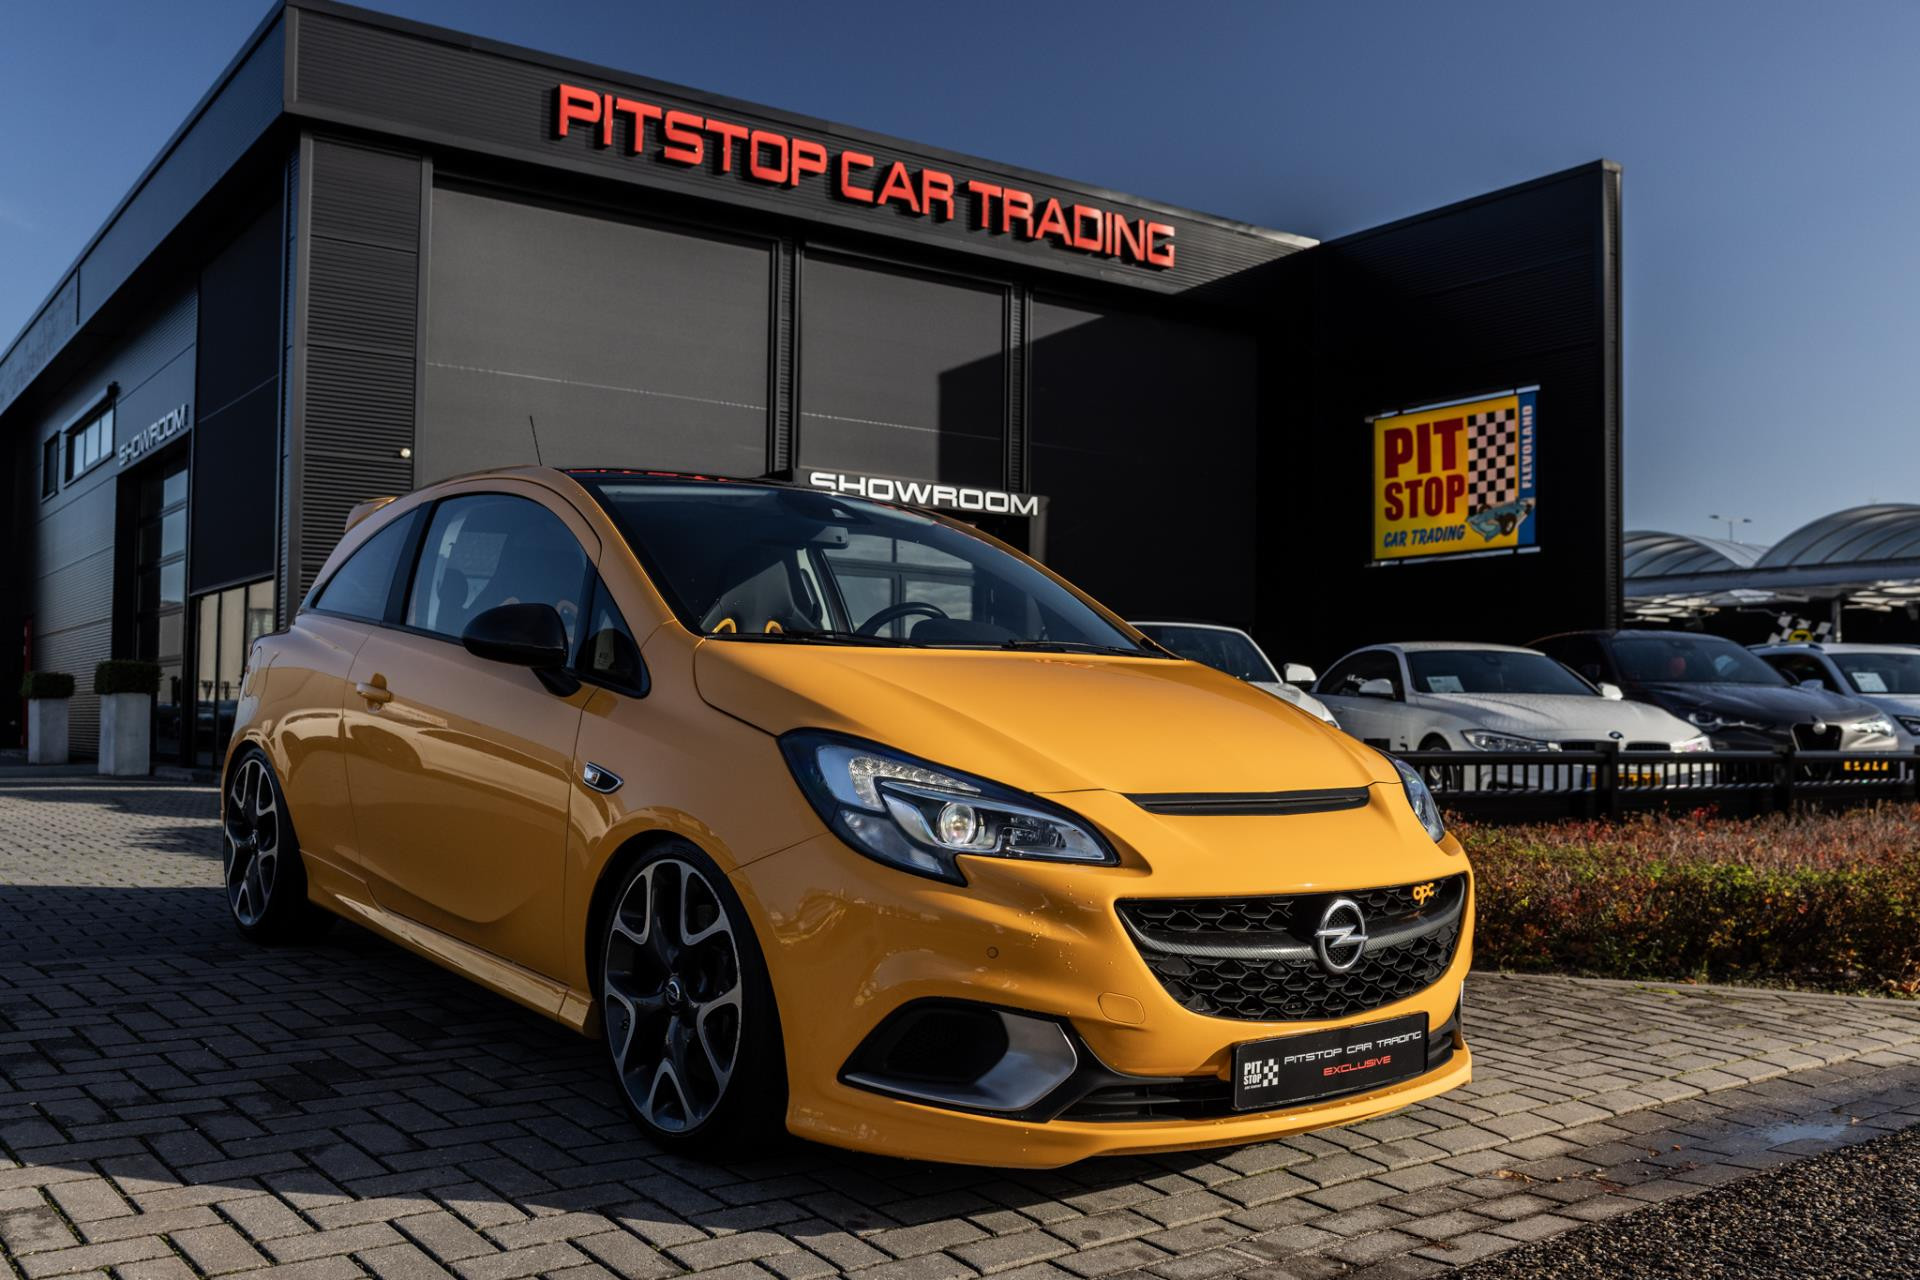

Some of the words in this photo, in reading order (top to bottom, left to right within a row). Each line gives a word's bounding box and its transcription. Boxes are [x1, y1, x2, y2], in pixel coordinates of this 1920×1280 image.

[558, 83, 828, 187] PITSTOP
[840, 152, 955, 221] CAR
[968, 180, 1175, 269] TRADING
[119, 404, 185, 466] SHOWROOM
[1384, 418, 1464, 479] PIT
[1522, 405, 1533, 489] FLEVOLAND
[809, 471, 1039, 516] SHOWROOM
[1384, 474, 1465, 522] STOP
[1384, 531, 1407, 548] CAR
[1411, 524, 1465, 545] TRADING
[1244, 1060, 1262, 1076] PIT
[1284, 1048, 1342, 1064] PITSTOP
[1346, 1042, 1372, 1054] CAR
[1376, 1031, 1422, 1048] TRADING
[1323, 1056, 1392, 1076] EXCLUSIVE
[1244, 1074, 1261, 1085] STOP
